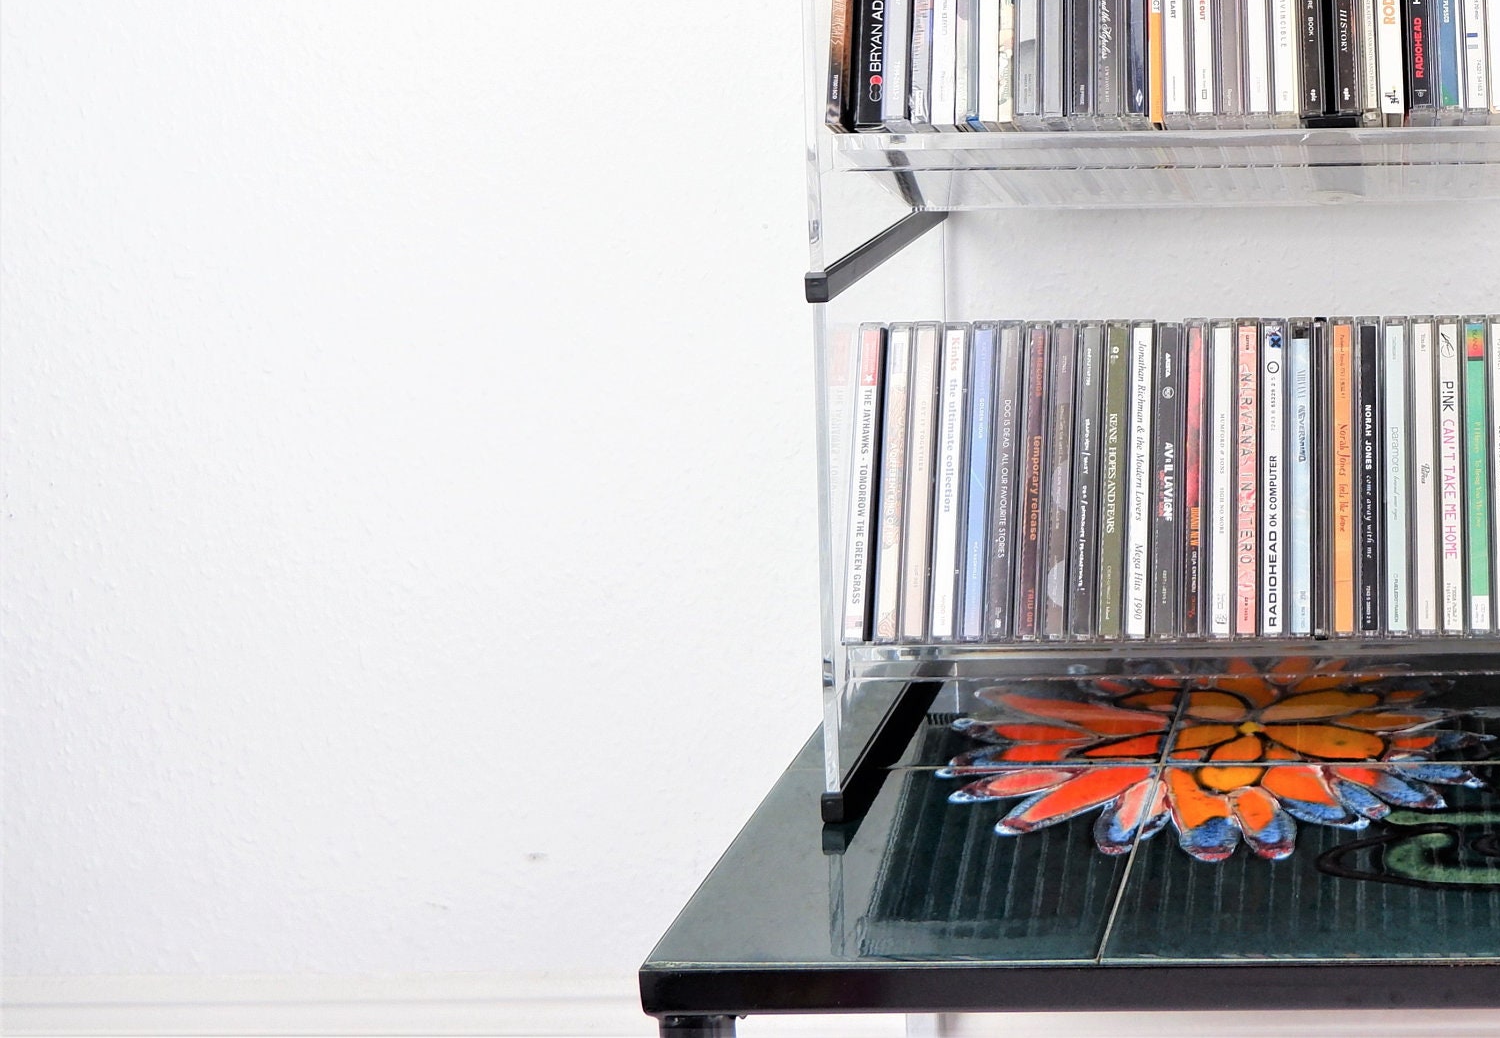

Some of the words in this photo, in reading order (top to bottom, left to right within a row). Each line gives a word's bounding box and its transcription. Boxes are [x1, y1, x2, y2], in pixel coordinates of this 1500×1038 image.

[1340, 10, 1348, 52] HISTORY
[870, 24, 882, 72] BRYAN
[1413, 17, 1424, 78] RADIOHEAD
[1137, 340, 1147, 382] Jonathan
[864, 388, 873, 406] THE
[1003, 399, 1012, 418] DOG
[1137, 385, 1146, 423] Richman
[1442, 381, 1454, 412] P!NK
[861, 408, 872, 454] JAYHAWKS
[1109, 413, 1118, 443] KEANE
[1136, 425, 1144, 434] &
[1364, 404, 1372, 437] NORAH
[1002, 427, 1010, 448] DEAD.
[1136, 436, 1145, 450] the
[1443, 418, 1456, 461] CAN'T
[1001, 453, 1009, 466] ALL
[1030, 435, 1042, 494] temporary
[1108, 447, 1117, 479] HOPES
[1136, 453, 1145, 488] Modern
[856, 464, 868, 517] TOMORROW
[1107, 480, 1116, 502] AND
[1269, 455, 1278, 510] COMPUTER
[1444, 465, 1456, 500] TAKE
[999, 486, 1008, 525] FAVOURITE
[1030, 498, 1040, 541] release
[1106, 504, 1115, 534] FEARS
[1135, 491, 1144, 521] Lovers
[1269, 512, 1277, 528] OK
[1444, 503, 1457, 521] ME
[856, 520, 865, 537] THE
[998, 528, 1006, 558] STORIES
[1445, 525, 1457, 560] HOME
[854, 540, 864, 571] GREEN
[1132, 543, 1143, 569] Mega
[852, 574, 862, 604] GRASS
[1134, 572, 1143, 591] Hits
[1268, 530, 1278, 627] RADIOHEAD
[1134, 596, 1142, 620] 1990
